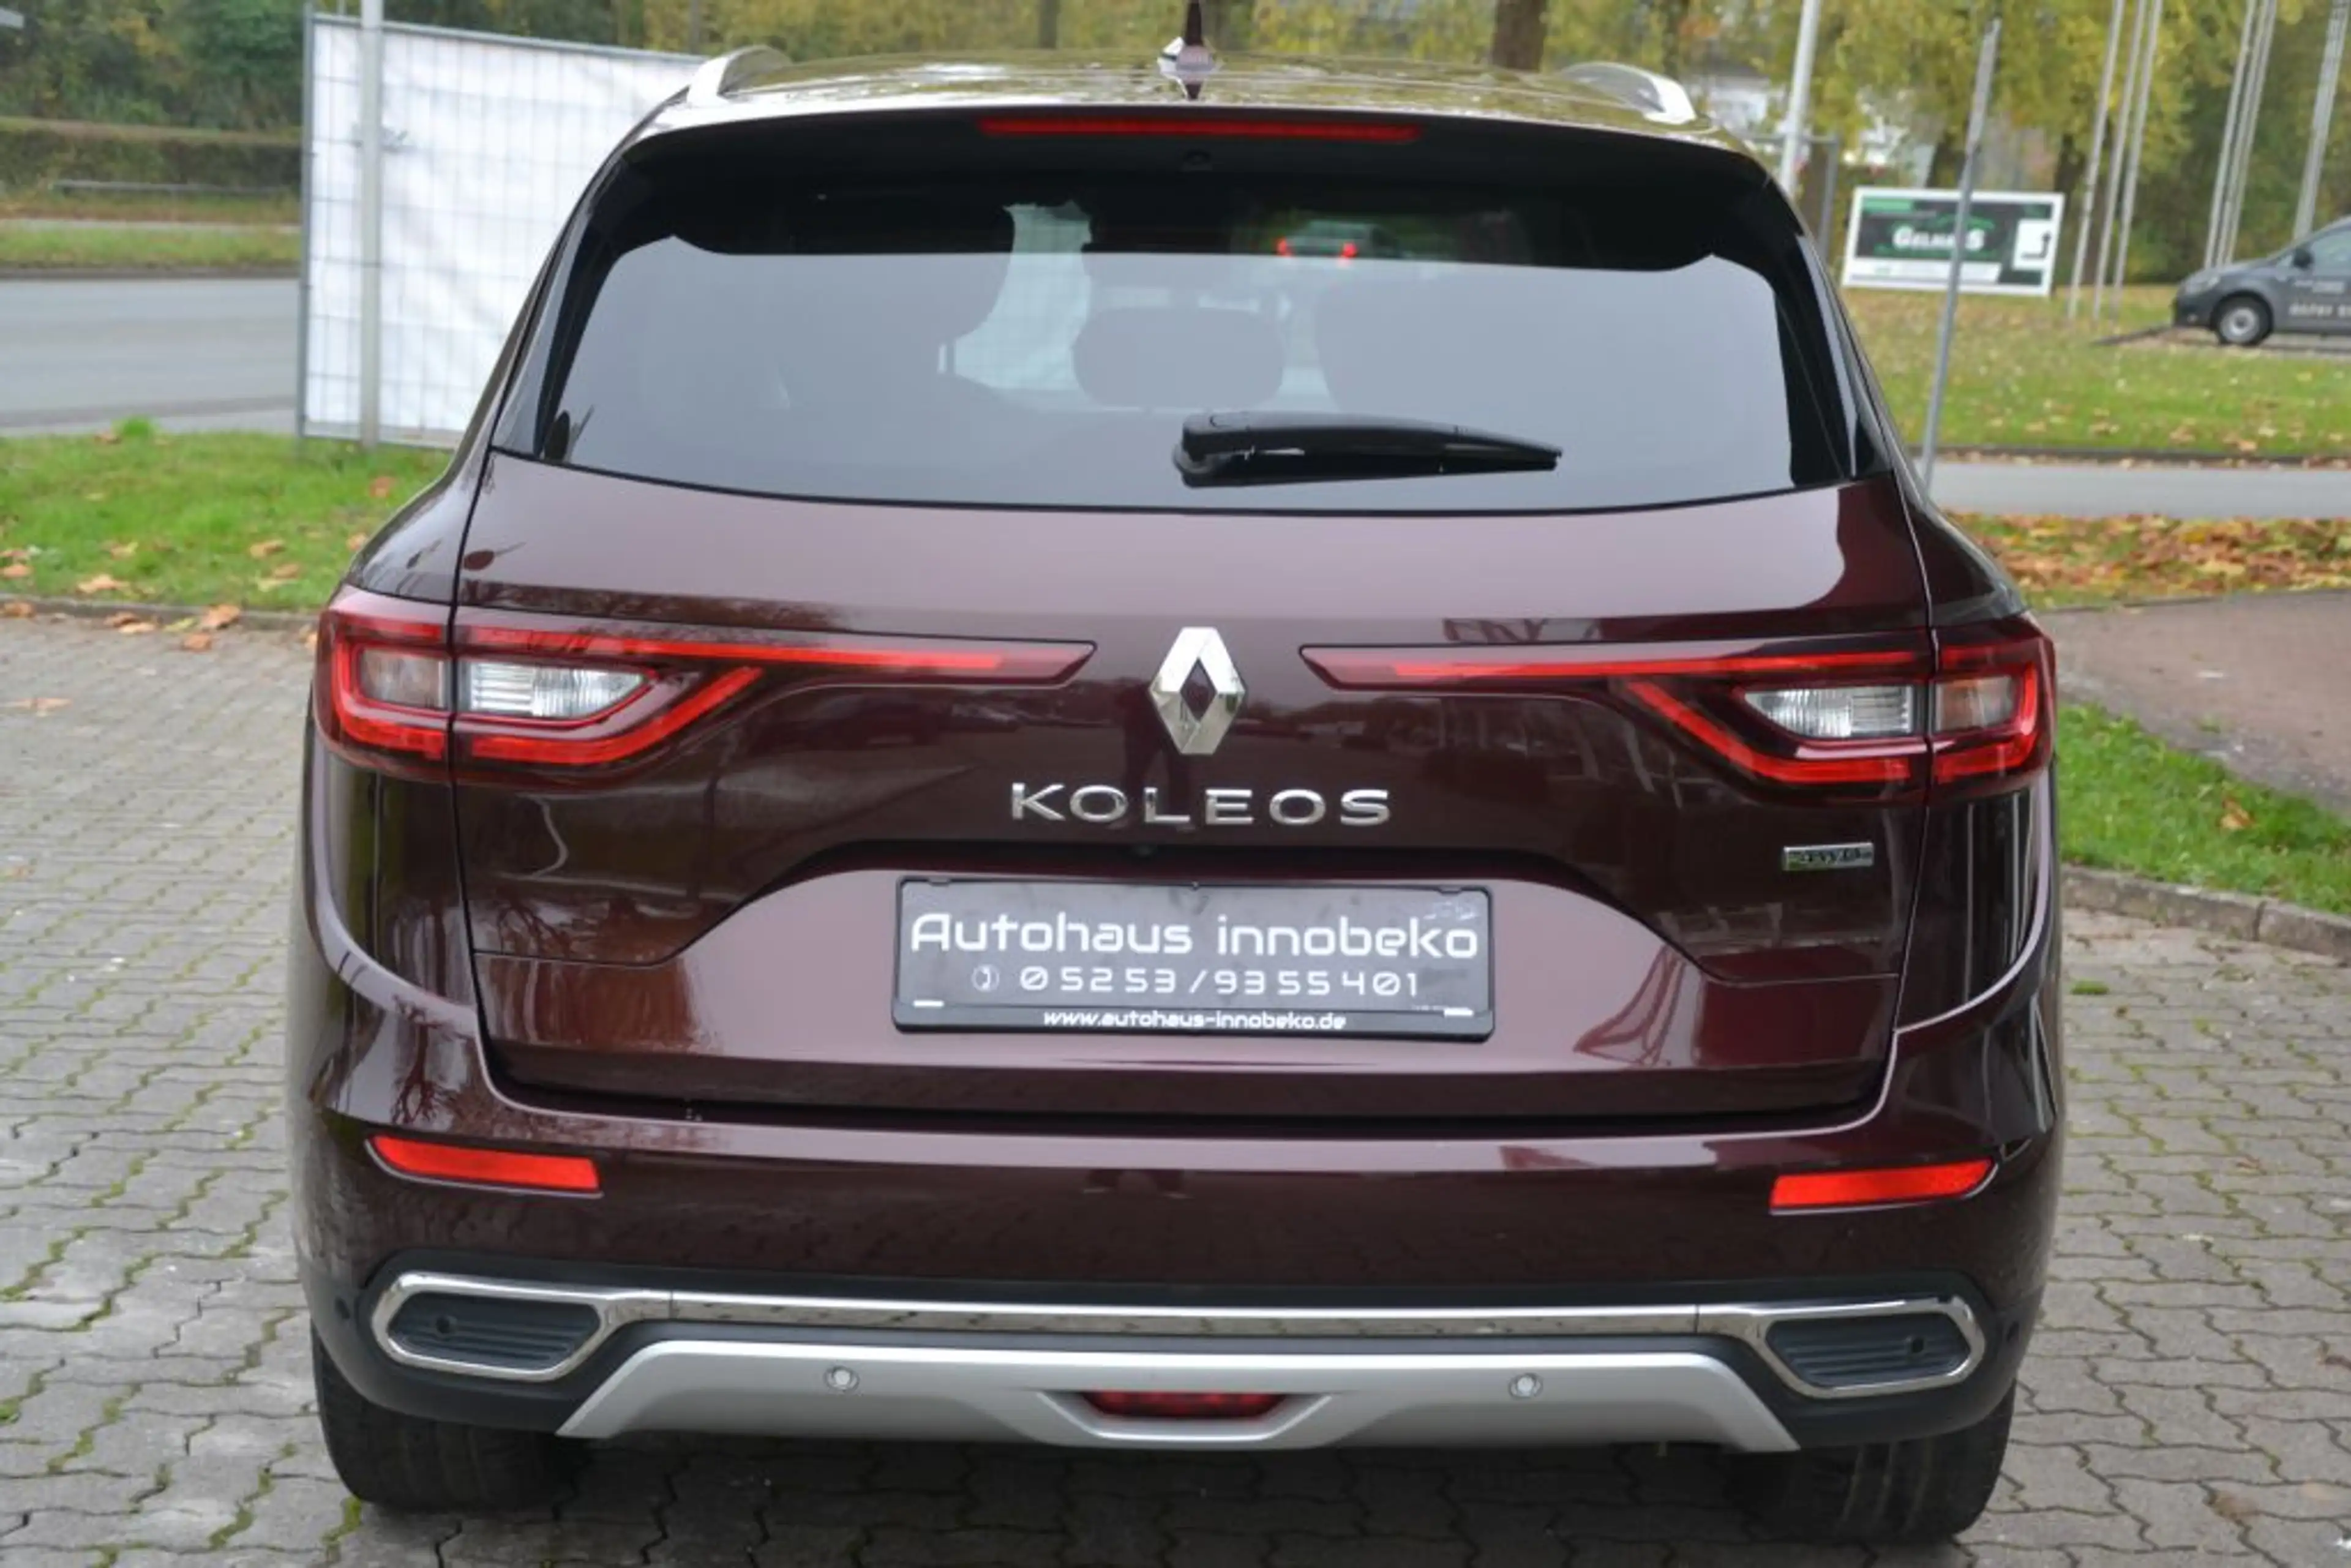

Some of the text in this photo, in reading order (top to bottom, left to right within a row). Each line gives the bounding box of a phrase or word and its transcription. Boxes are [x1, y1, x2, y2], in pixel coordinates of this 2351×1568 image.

[1011, 782, 1390, 826] KOLEOS
[910, 910, 1479, 960] Autohaus innobeko
[1043, 1010, 1347, 1030] www.autohaus-innobeko.de
